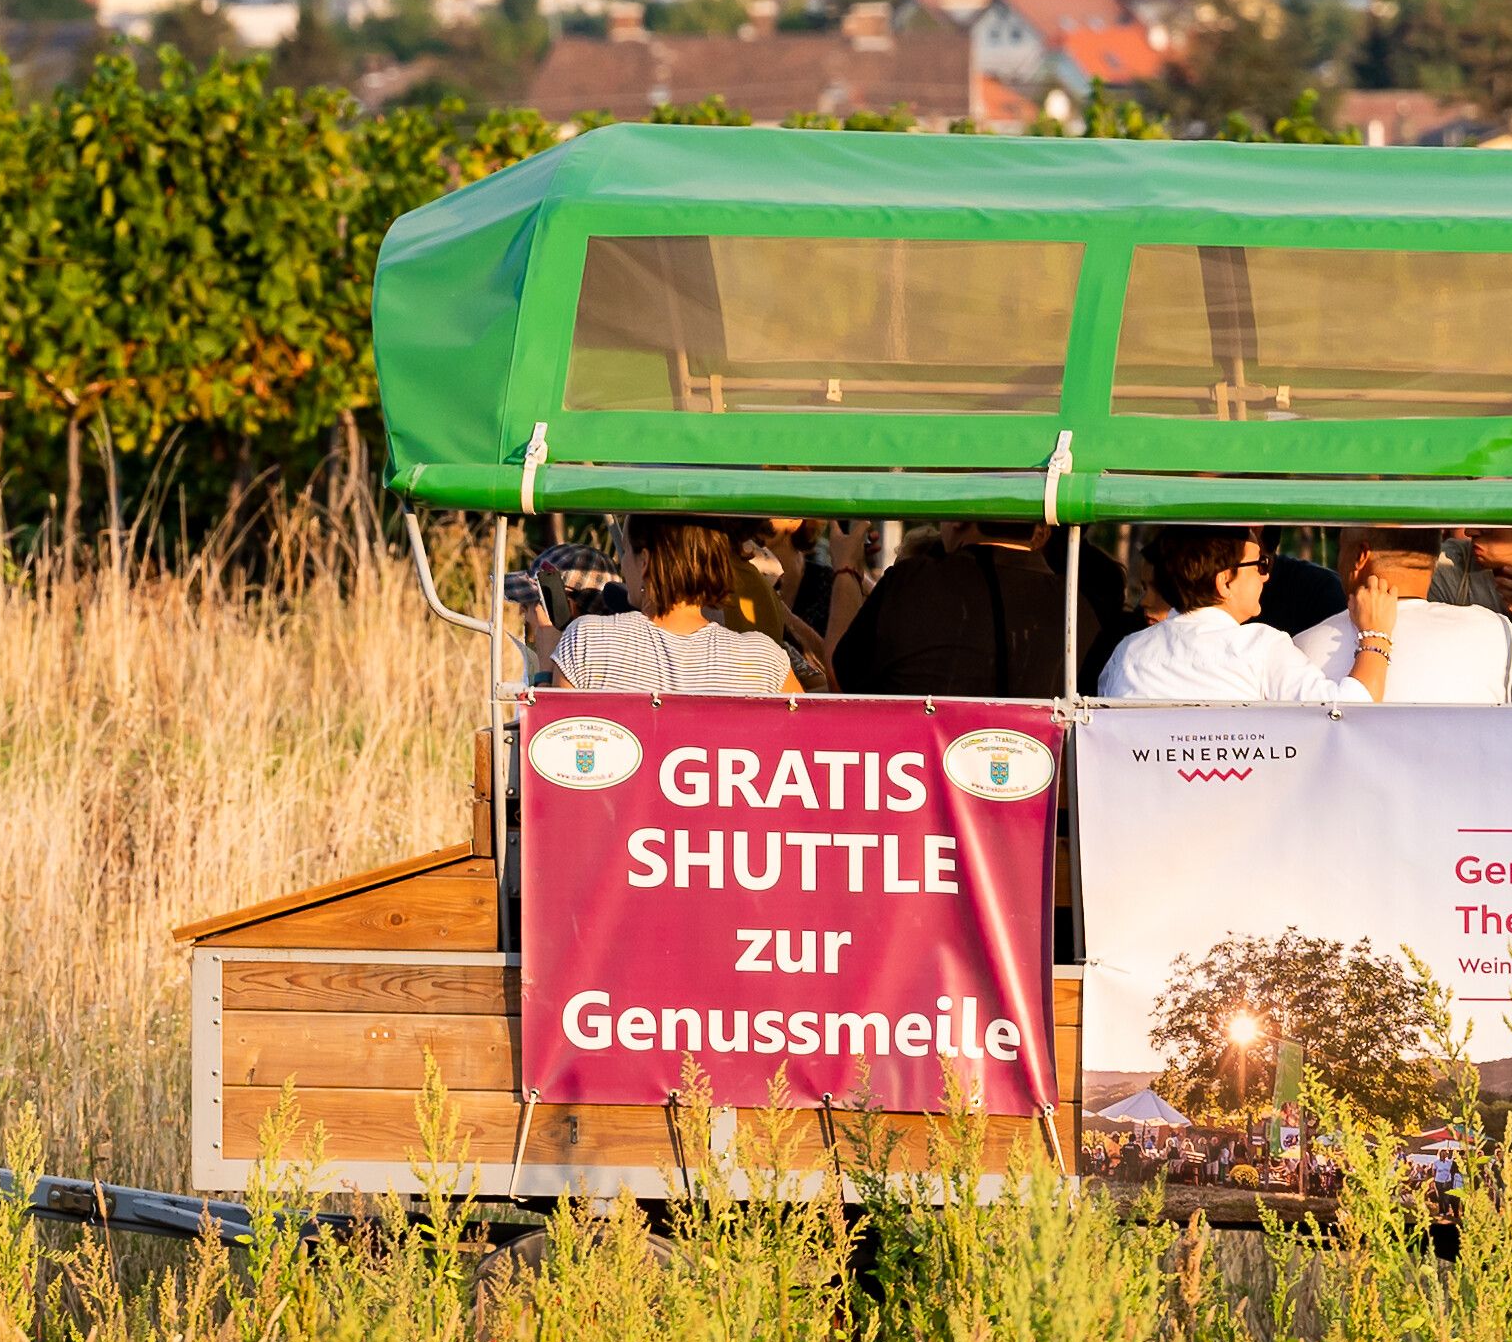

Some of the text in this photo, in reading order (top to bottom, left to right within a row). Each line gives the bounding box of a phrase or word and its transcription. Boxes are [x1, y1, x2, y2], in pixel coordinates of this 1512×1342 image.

[1132, 746, 1297, 762] WIENERWALD
[1170, 733, 1266, 742] THERMENREGION
[659, 747, 927, 812] GRATIS
[626, 827, 959, 895] SHUTTLE
[734, 927, 852, 975] zur
[561, 990, 1021, 1061] Genussmeile
